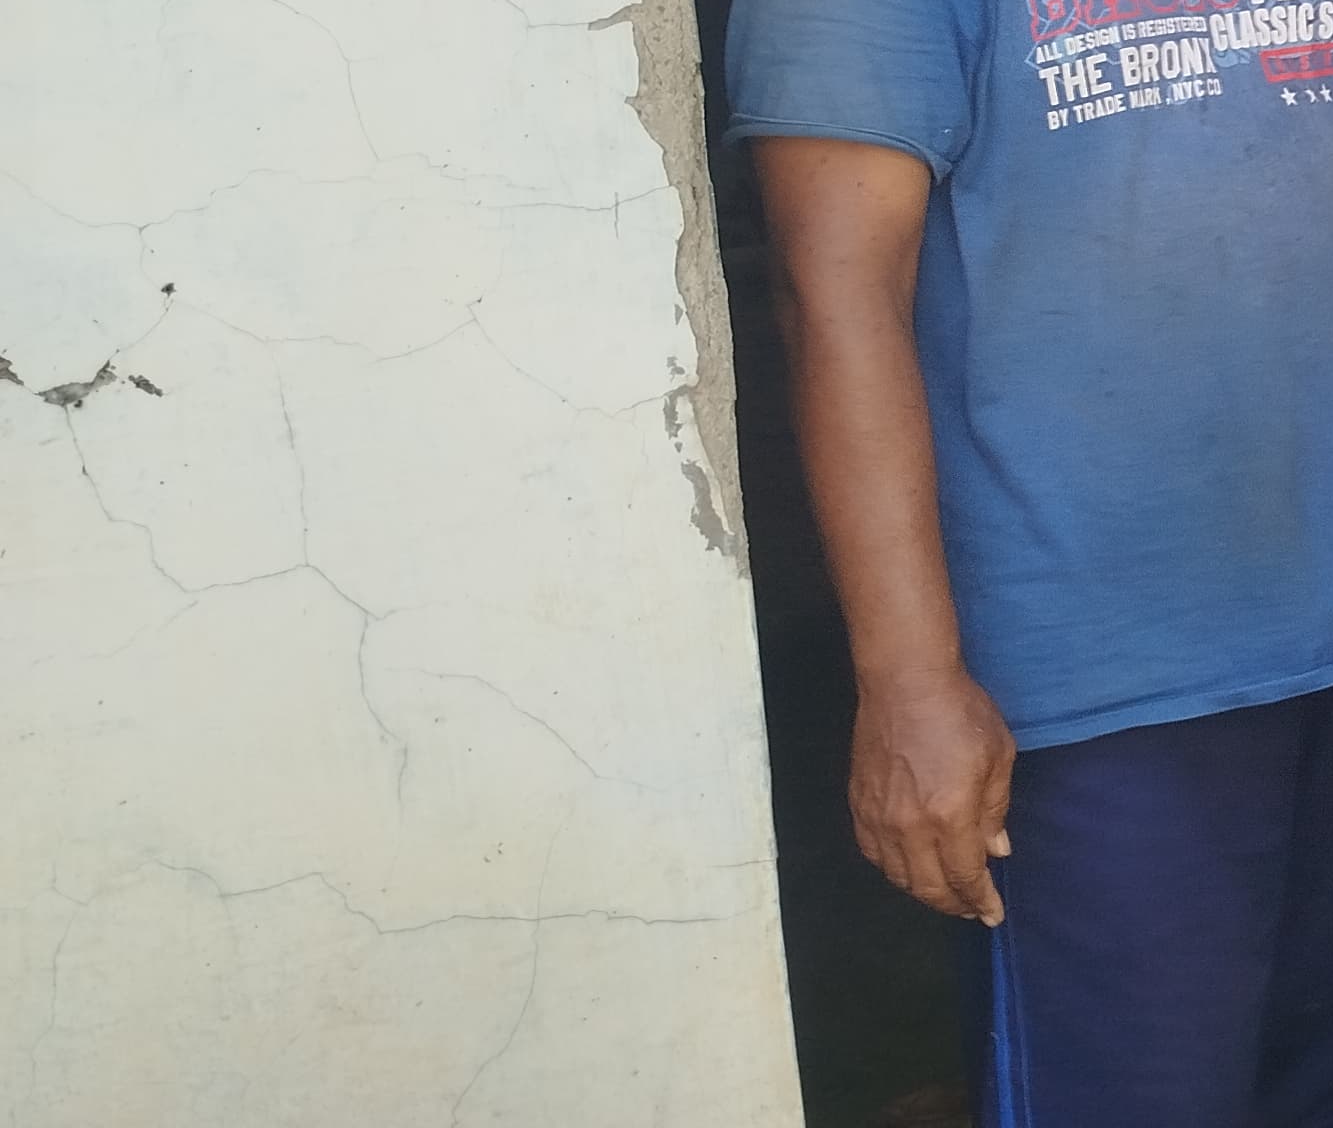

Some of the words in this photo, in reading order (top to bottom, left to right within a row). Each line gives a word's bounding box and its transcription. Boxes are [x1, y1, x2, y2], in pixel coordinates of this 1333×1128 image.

[1036, 44, 1063, 64] ALL
[1064, 26, 1120, 50] DESIGN
[1121, 22, 1137, 42] IS
[1137, 16, 1208, 39] REGISTERED
[1209, 4, 1314, 51] CLASSIC
[1039, 53, 1112, 106] THE
[1119, 37, 1217, 86] BRONX
[1047, 108, 1070, 131] BY
[1073, 93, 1127, 123] TRADE
